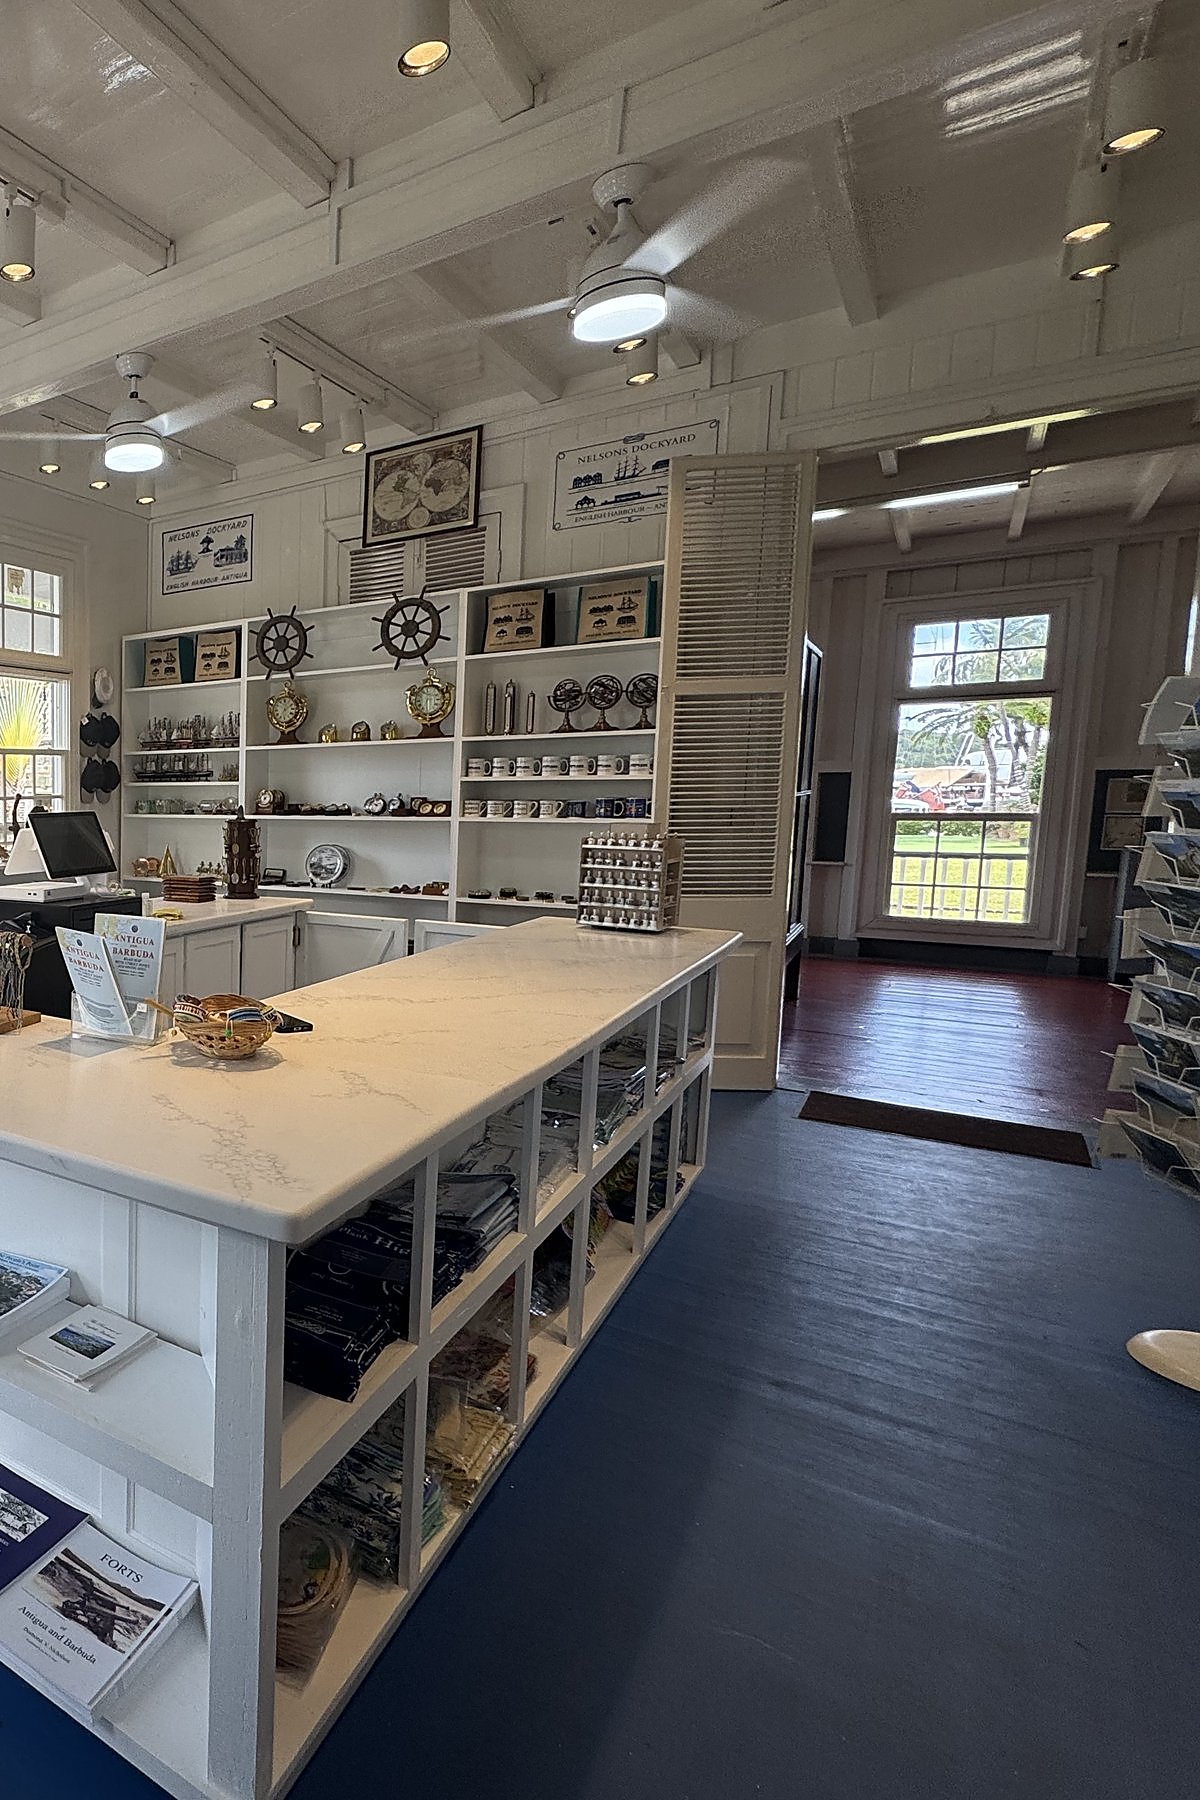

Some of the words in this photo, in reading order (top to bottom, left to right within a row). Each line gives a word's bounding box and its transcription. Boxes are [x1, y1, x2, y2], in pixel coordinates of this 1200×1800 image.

[577, 448, 628, 465] NELSONS
[631, 433, 696, 454] DOCKYARD
[574, 511, 604, 523] ENGLISH
[603, 506, 645, 518] HARBOUR
[168, 529, 201, 543] NELSONS
[206, 520, 248, 535] DOCKYARD
[166, 581, 189, 591] ENGLISH
[191, 576, 218, 587] HARBOUR
[221, 571, 248, 582] ANTIGUA
[114, 934, 155, 946] ANTIGUA
[66, 945, 100, 961] ANTIGUA
[112, 947, 155, 960] BARBUDA
[67, 956, 105, 972] BARBUDA
[100, 1552, 144, 1584] FORTS
[18, 1604, 49, 1632] Antigua
[48, 1627, 65, 1642] and
[63, 1637, 97, 1665] Barbuda
